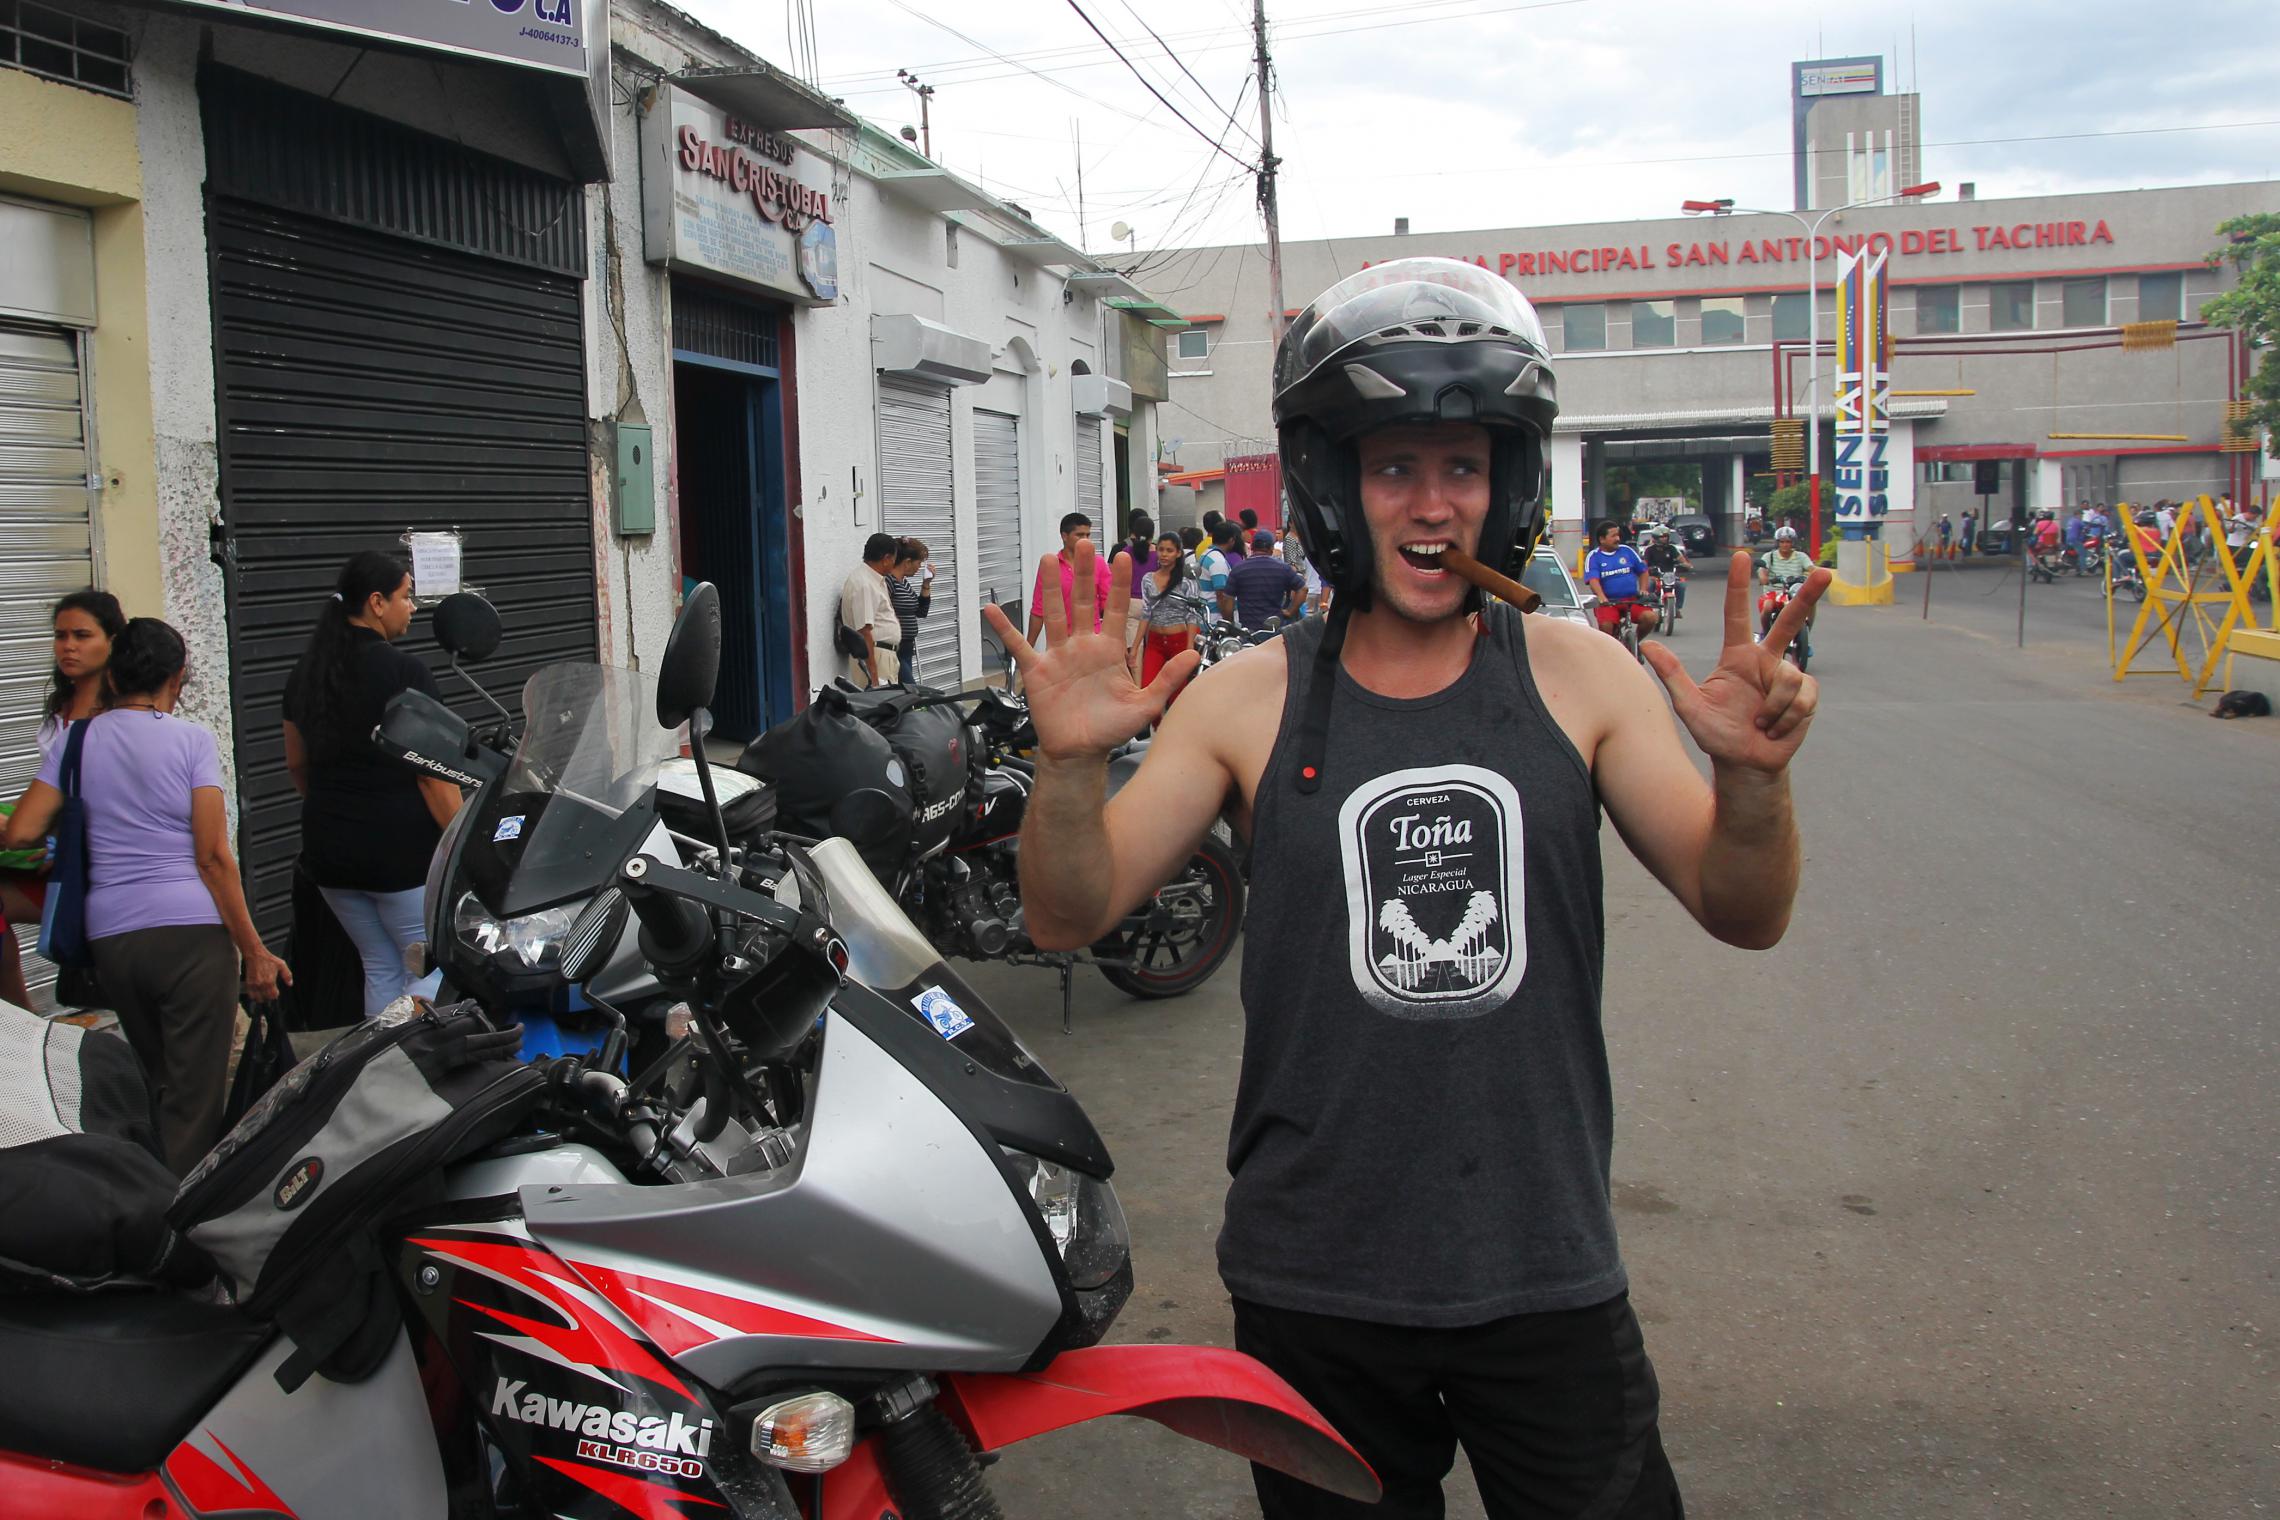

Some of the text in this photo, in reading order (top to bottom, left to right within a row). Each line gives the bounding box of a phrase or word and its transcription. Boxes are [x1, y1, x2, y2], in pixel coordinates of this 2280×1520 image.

[519, 27, 579, 47] J-40064137-3
[726, 117, 796, 166] EXPRESOS
[679, 124, 730, 181] SAN
[729, 146, 834, 223] CRISTOBAL
[1500, 245, 1656, 276] PRINCIPAL
[1667, 240, 1729, 267] SAN
[1737, 231, 1894, 264] ANTONIO
[1901, 227, 1964, 255] DEL
[1972, 219, 2114, 250] TACHIRA
[1836, 364, 1862, 516] SENIAT
[1869, 362, 1889, 516] SENIAT
[403, 751, 483, 788] Barkbusters
[1406, 795, 1450, 807] CERVEZA
[1389, 813, 1473, 852] Toña
[1397, 879, 1474, 896] NICARAGUA
[1402, 867, 1467, 883] Lager Especial
[491, 1376, 713, 1457] Kawasaki
[576, 1438, 703, 1479] KLR650
